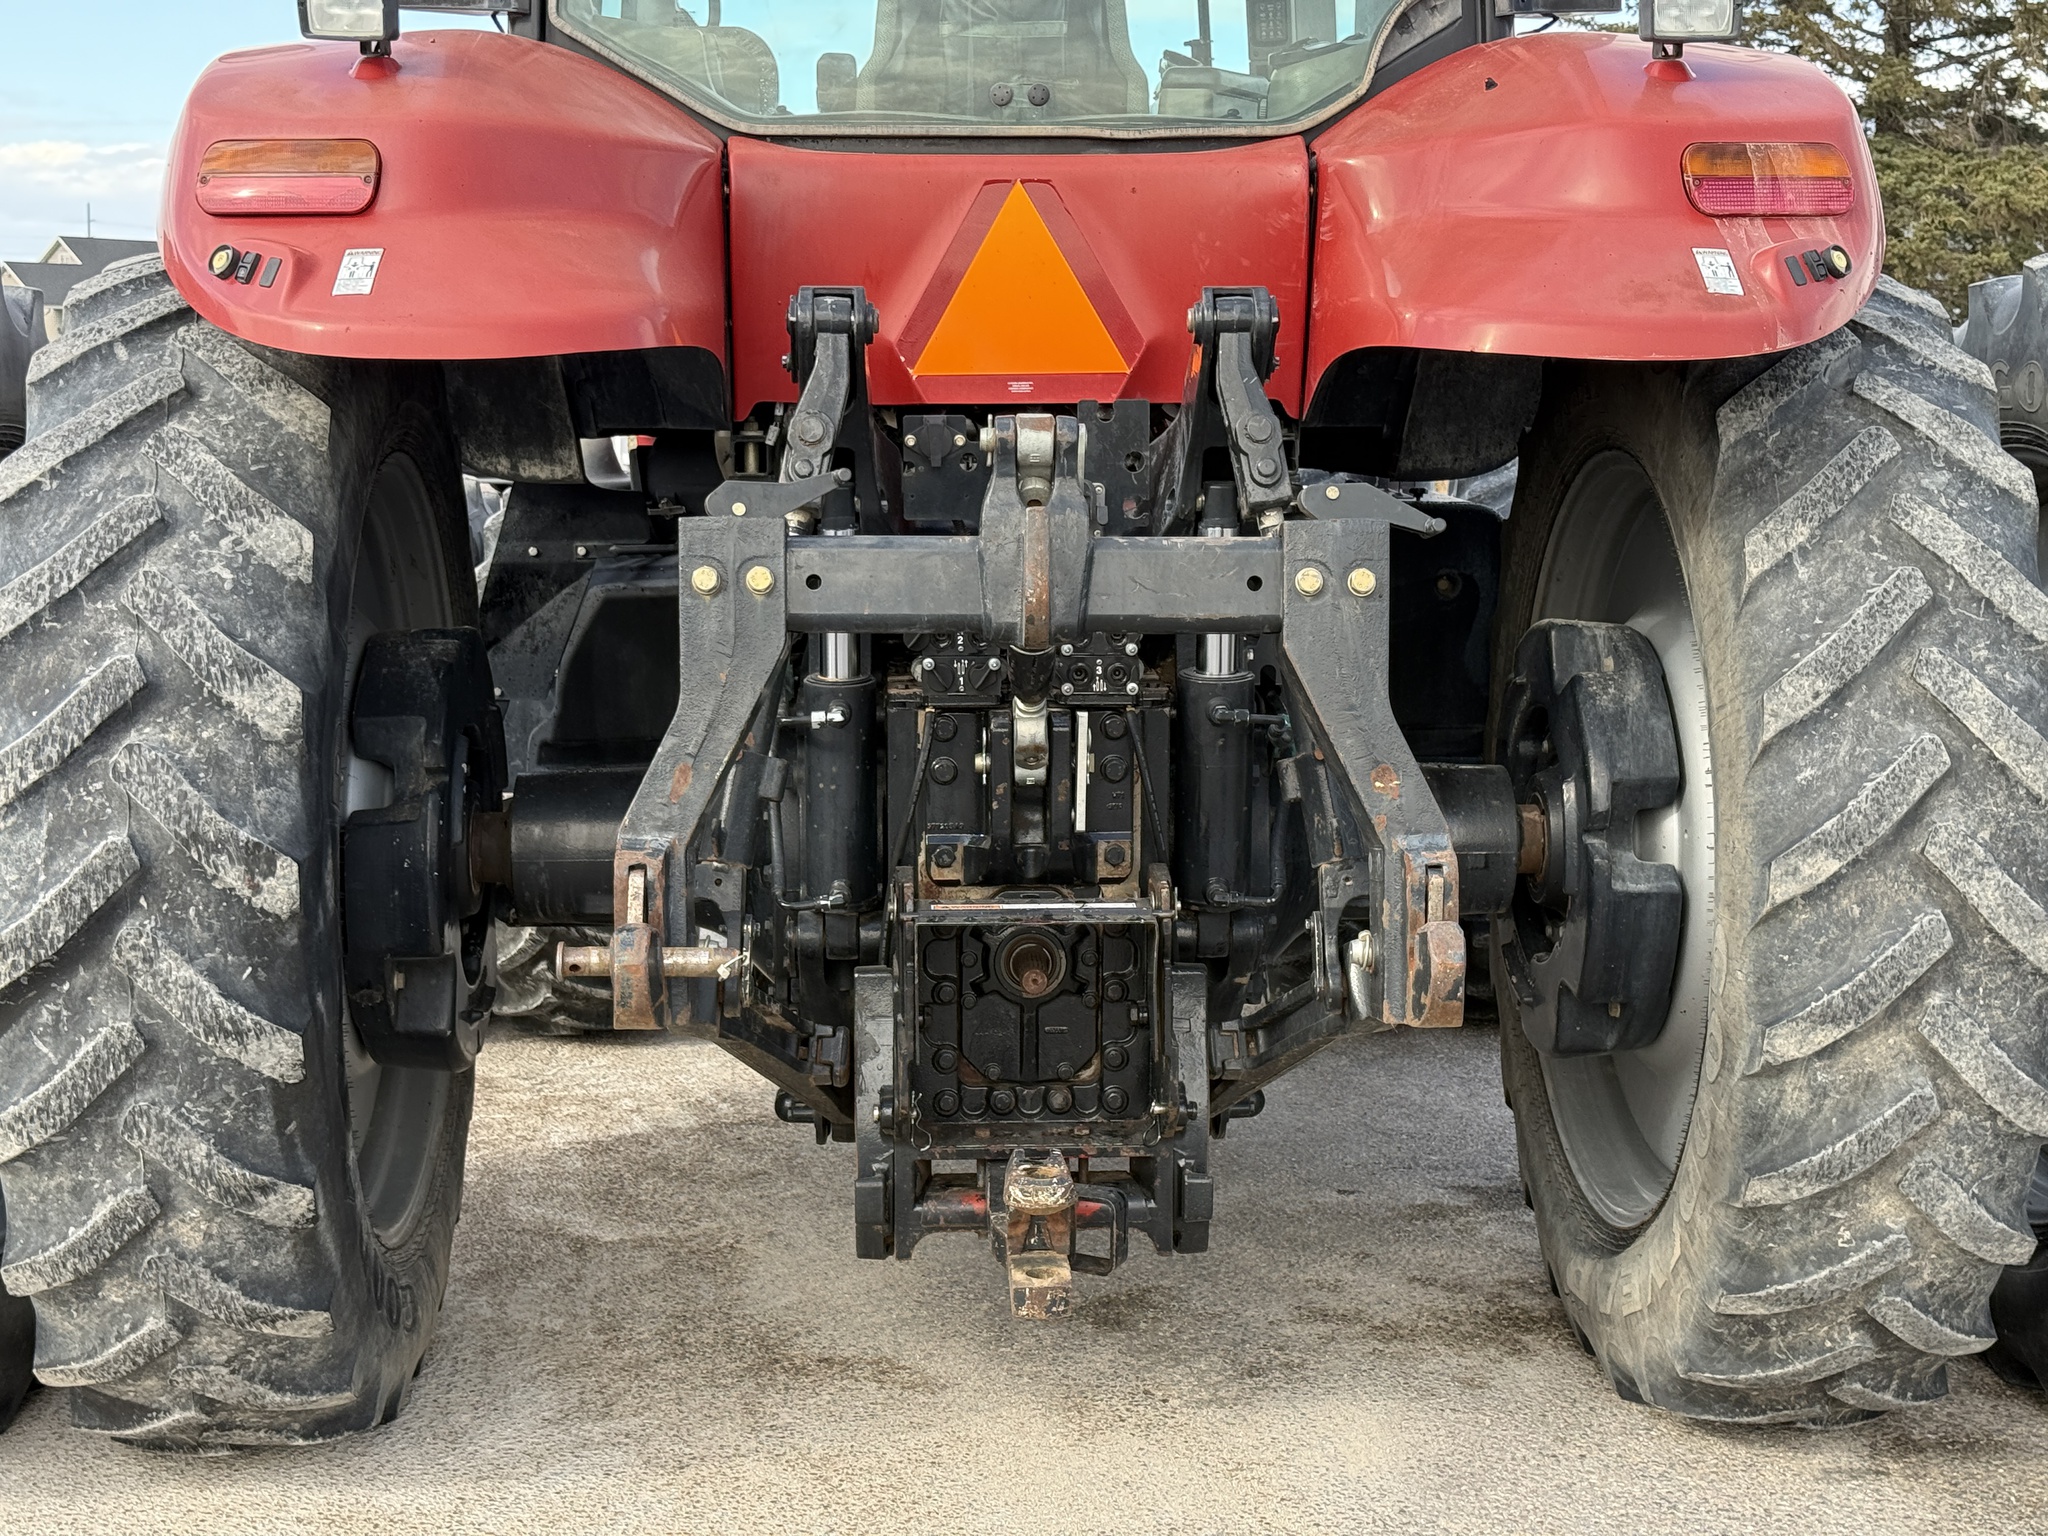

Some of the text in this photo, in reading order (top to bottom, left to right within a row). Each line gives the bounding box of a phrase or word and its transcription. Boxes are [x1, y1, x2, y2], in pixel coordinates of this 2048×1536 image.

[1991, 358, 2048, 413] GO
[957, 635, 964, 645] 2
[1095, 665, 1103, 675] 3
[958, 676, 964, 686] 1
